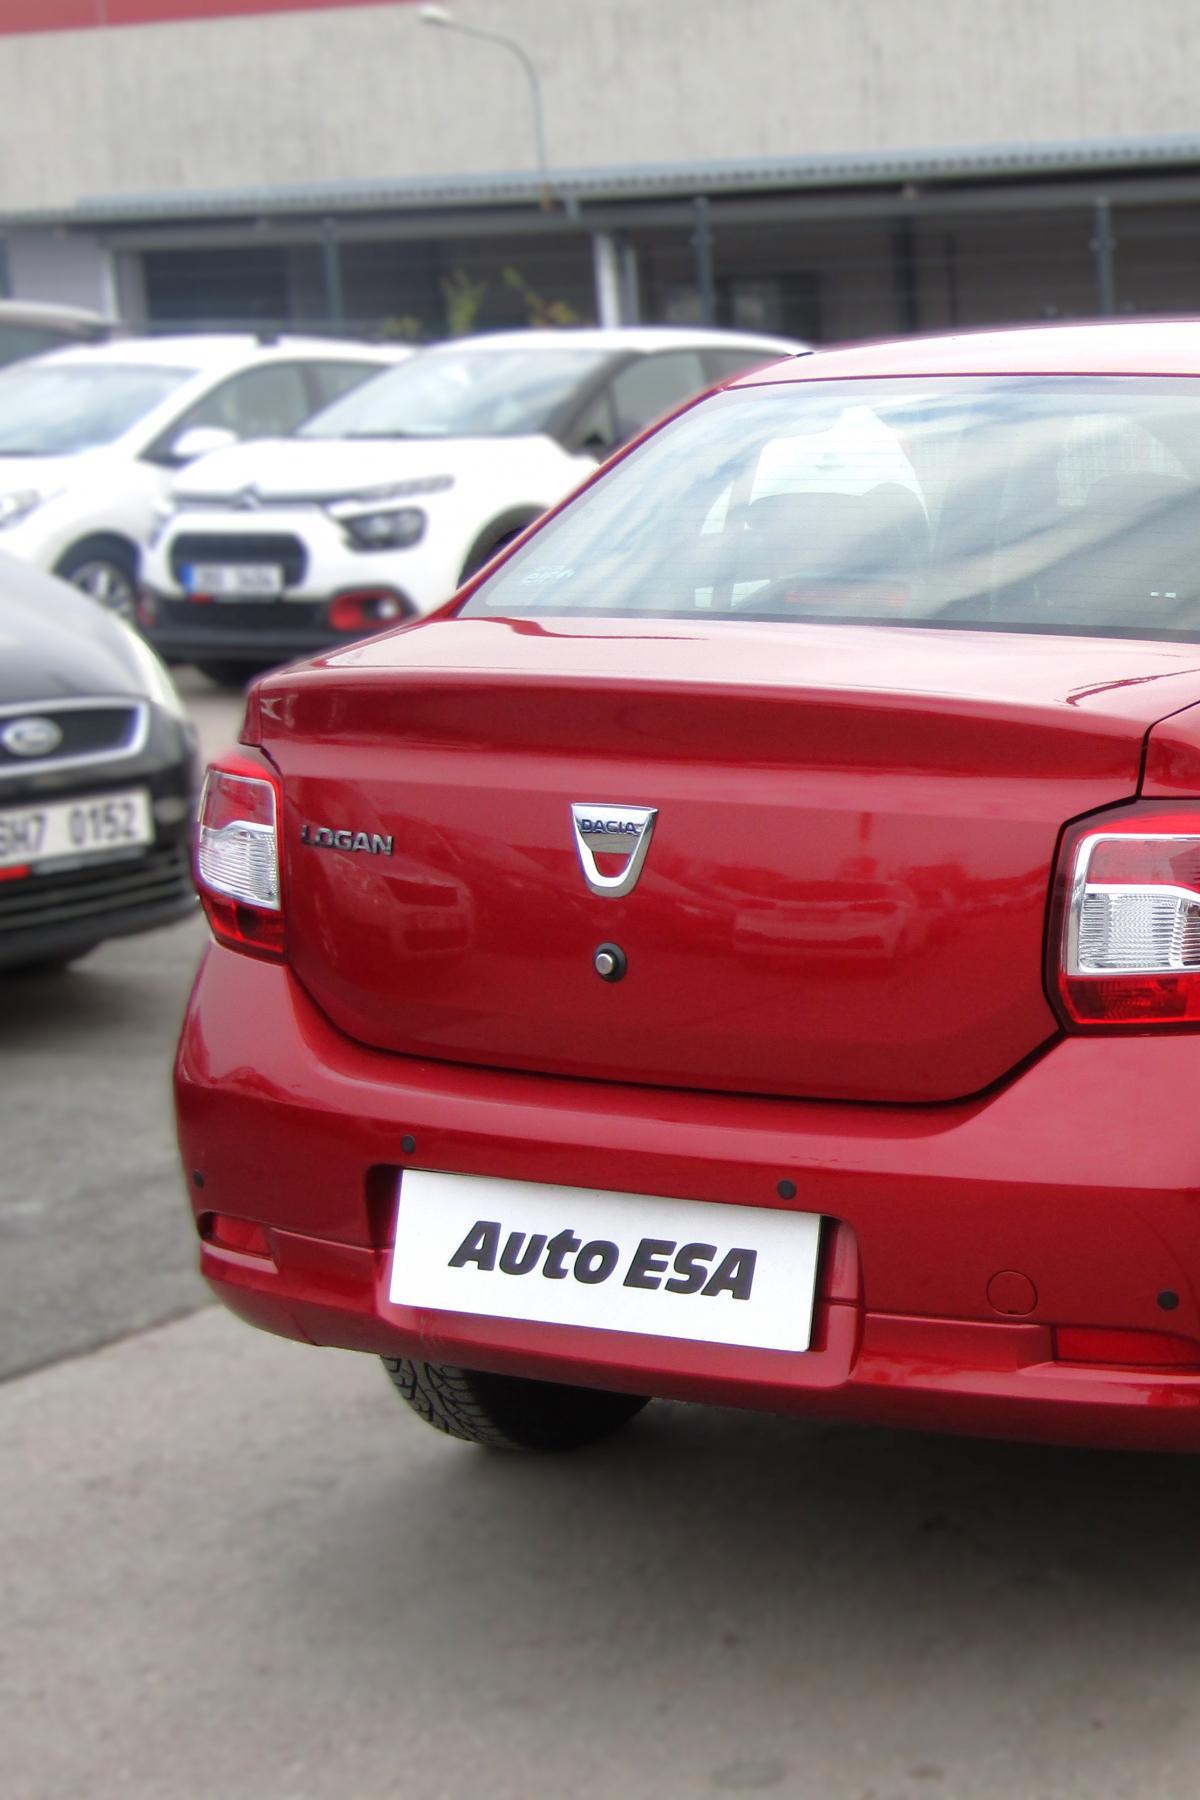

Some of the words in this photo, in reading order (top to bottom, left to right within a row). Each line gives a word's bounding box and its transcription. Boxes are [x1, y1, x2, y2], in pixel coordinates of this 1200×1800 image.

[302, 825, 394, 856] LOGAN
[580, 818, 639, 835] DACIA
[447, 1220, 620, 1285] Auto
[622, 1238, 758, 1301] ESA
